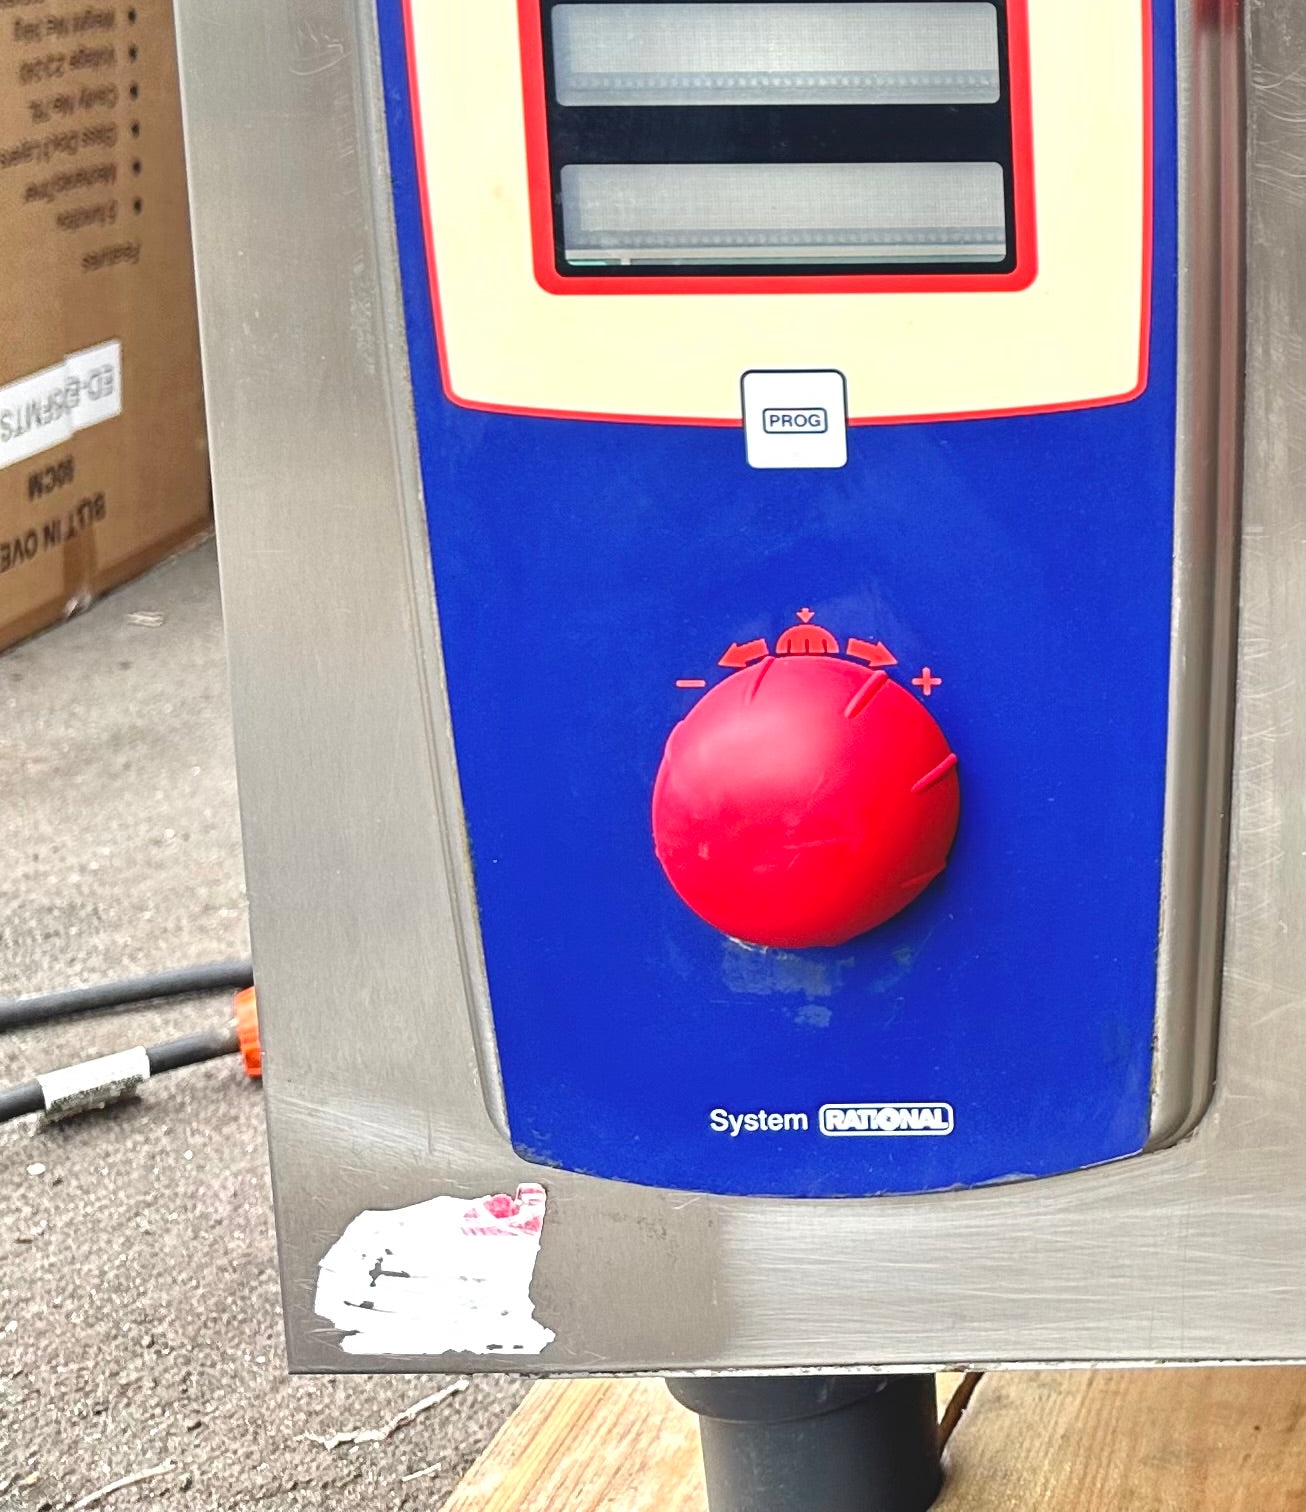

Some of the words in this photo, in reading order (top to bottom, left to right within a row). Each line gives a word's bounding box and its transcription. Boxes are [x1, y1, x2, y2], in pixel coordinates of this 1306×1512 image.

[769, 414, 821, 428] PROG
[709, 1108, 809, 1138] System
[825, 1108, 950, 1131] RATIONAL
